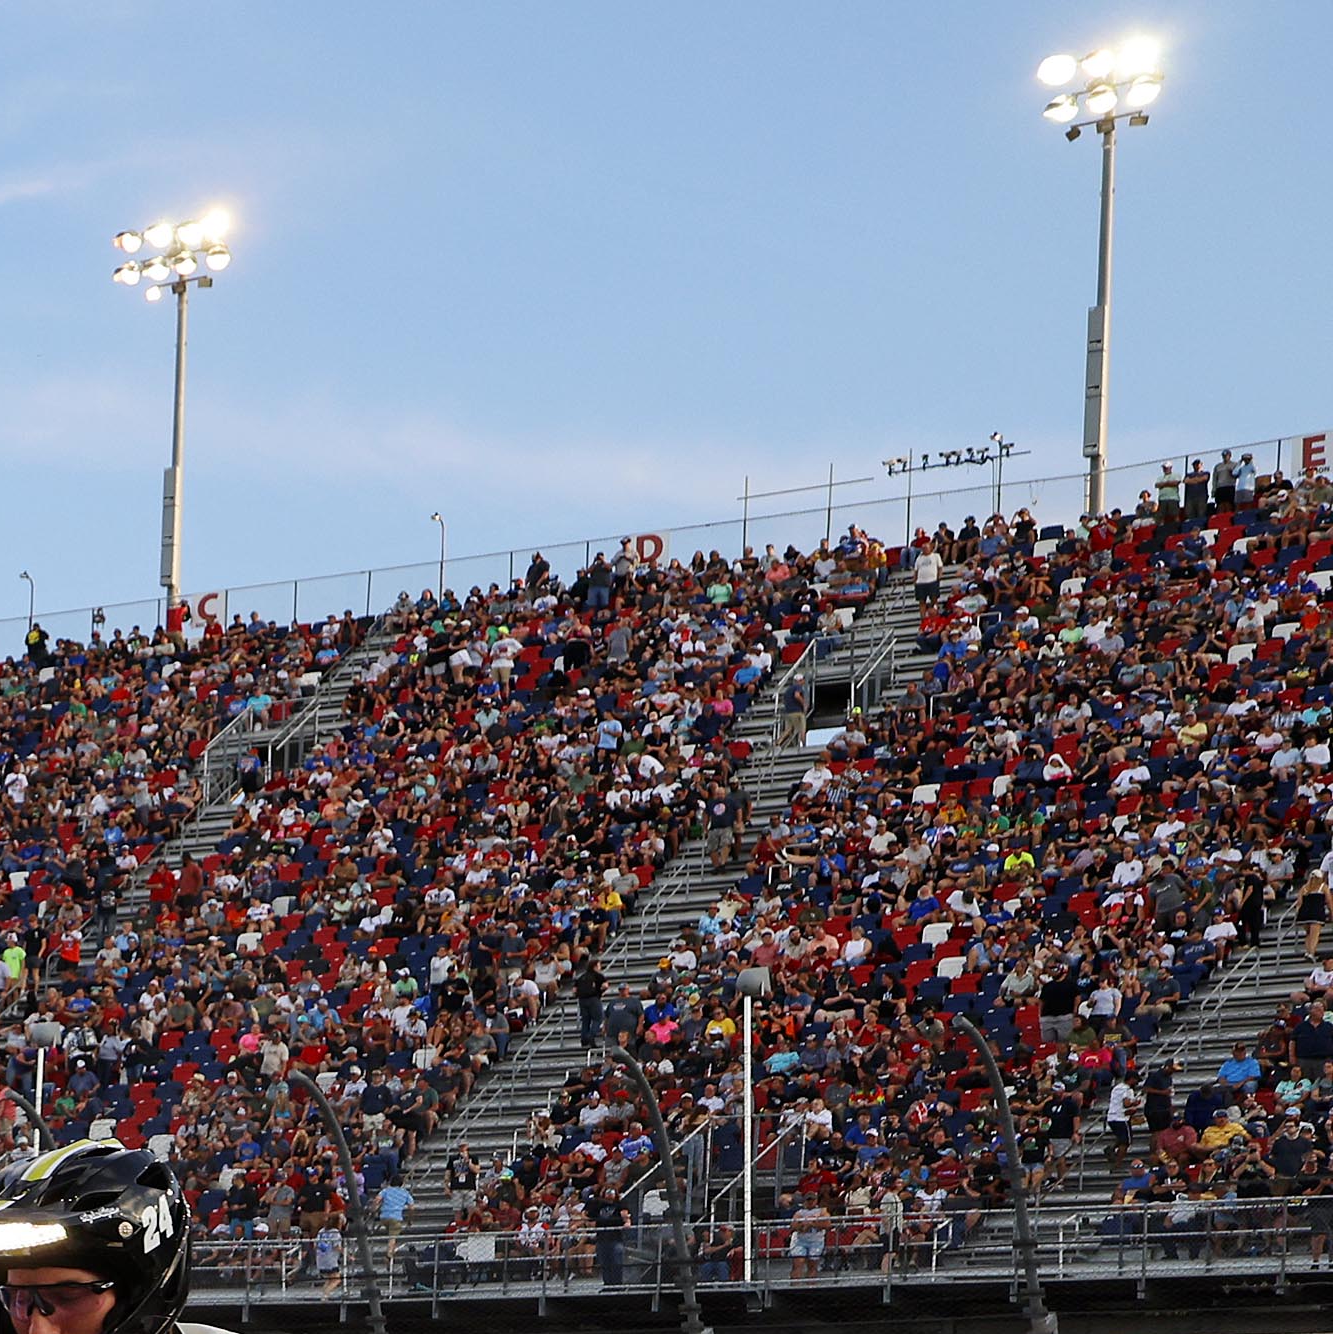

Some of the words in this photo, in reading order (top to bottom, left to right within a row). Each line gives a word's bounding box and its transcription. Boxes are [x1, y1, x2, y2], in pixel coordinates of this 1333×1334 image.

[1302, 433, 1326, 470] E
[637, 534, 663, 563] D
[198, 593, 219, 620] C
[142, 1194, 174, 1254] 24
